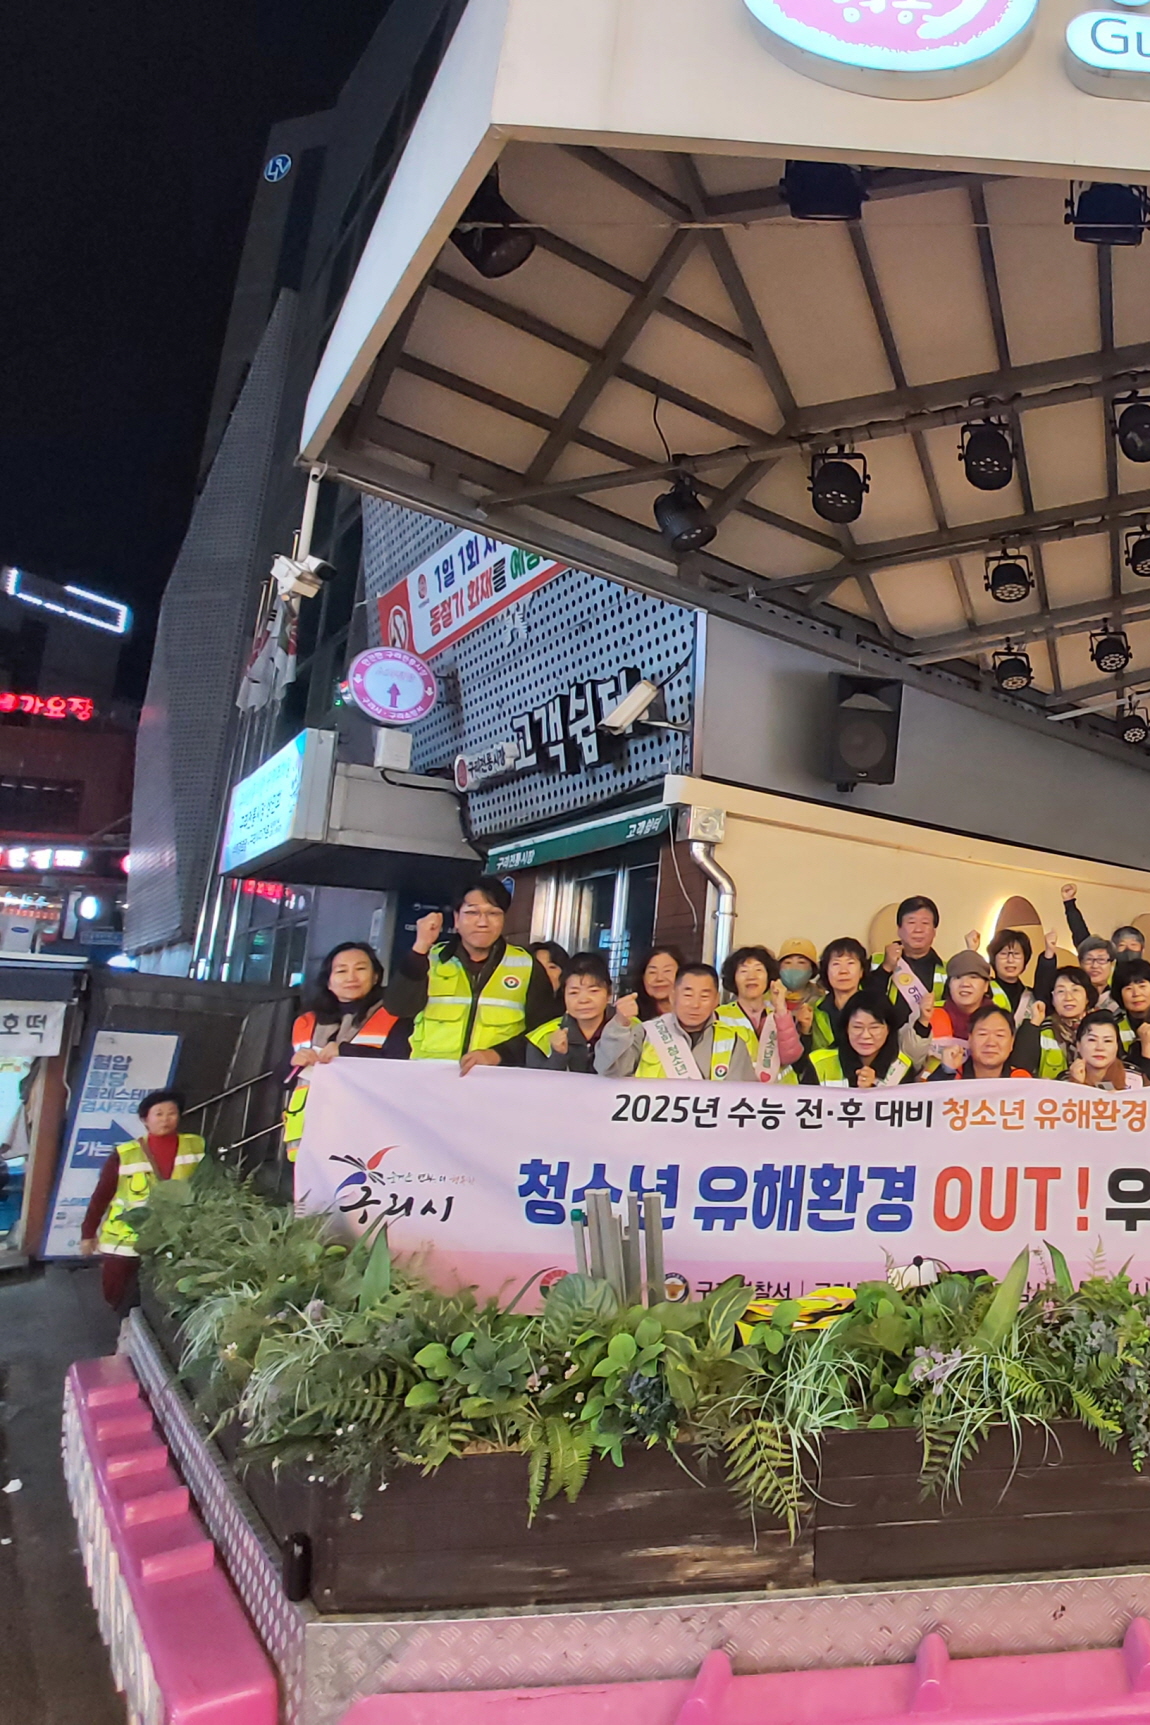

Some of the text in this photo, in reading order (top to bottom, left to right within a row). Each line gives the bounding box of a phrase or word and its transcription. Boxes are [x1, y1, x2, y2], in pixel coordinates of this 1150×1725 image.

[434, 555, 455, 593] 1일
[458, 535, 480, 575] 1회
[467, 557, 507, 612] 화재를
[496, 849, 536, 871] 구리전통시장
[610, 1092, 720, 1129] 2025년
[727, 1095, 786, 1131] 수능
[794, 1096, 867, 1131] 전·후
[875, 1098, 934, 1130] 대비
[941, 1097, 1026, 1132] 청소년
[1033, 1097, 1148, 1132] 유해환경
[338, 1185, 455, 1225] 구리시
[518, 1158, 680, 1231] 청소년
[693, 1162, 917, 1233] 유해환경
